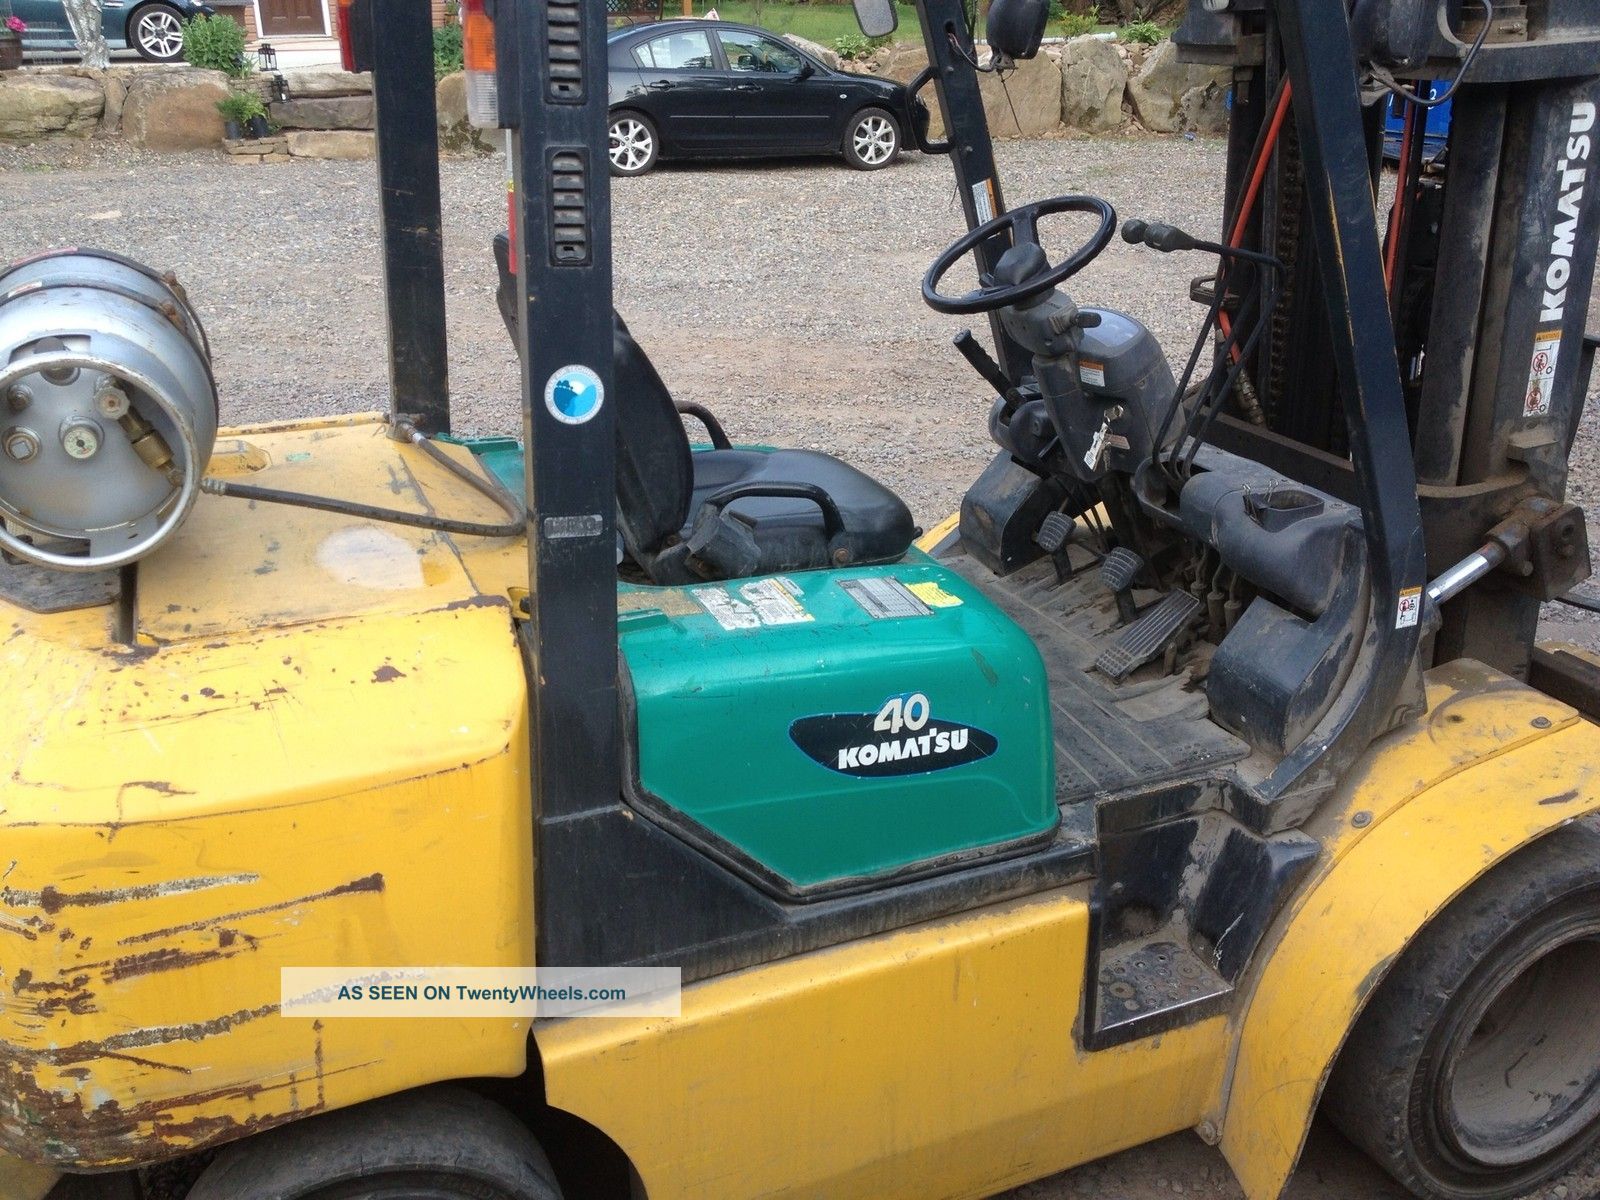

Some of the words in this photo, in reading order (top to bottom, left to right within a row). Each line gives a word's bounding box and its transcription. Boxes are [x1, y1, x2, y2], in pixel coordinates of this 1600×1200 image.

[1539, 102, 1596, 323] KOMATSU
[873, 693, 930, 734] 40
[838, 727, 969, 770] KOMATSU
